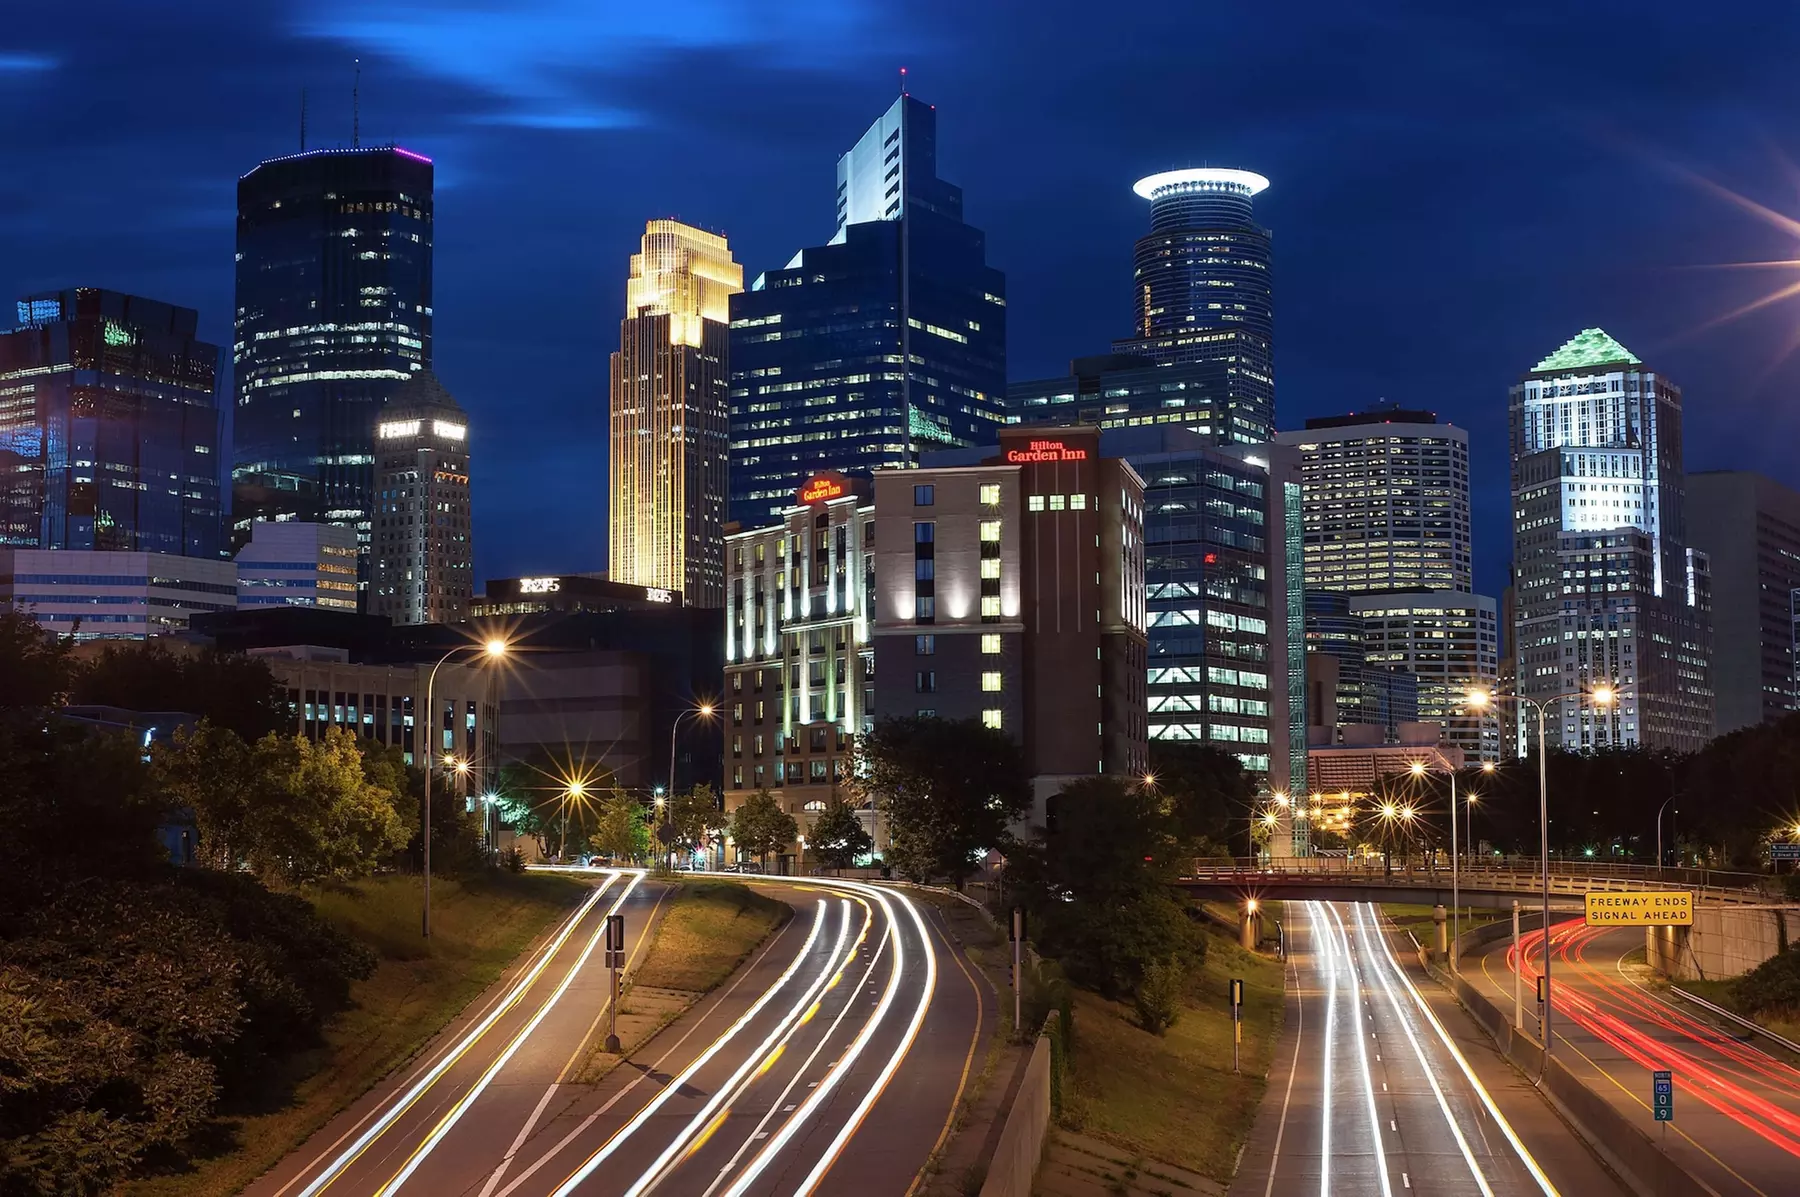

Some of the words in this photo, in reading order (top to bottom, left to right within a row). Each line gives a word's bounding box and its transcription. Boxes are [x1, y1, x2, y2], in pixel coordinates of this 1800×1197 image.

[1030, 441, 1063, 451] Hilton
[1008, 449, 1058, 462] Garden
[1061, 448, 1086, 460] Inn
[804, 489, 828, 501] Garden
[828, 485, 841, 496] Inn
[1590, 897, 1648, 906] FREEWAY
[1655, 897, 1687, 906] ENDS
[1592, 911, 1637, 920] SIGNAL
[1644, 911, 1687, 920] AHEAD
[1658, 1084, 1668, 1092] 65
[1659, 1094, 1667, 1105] 0
